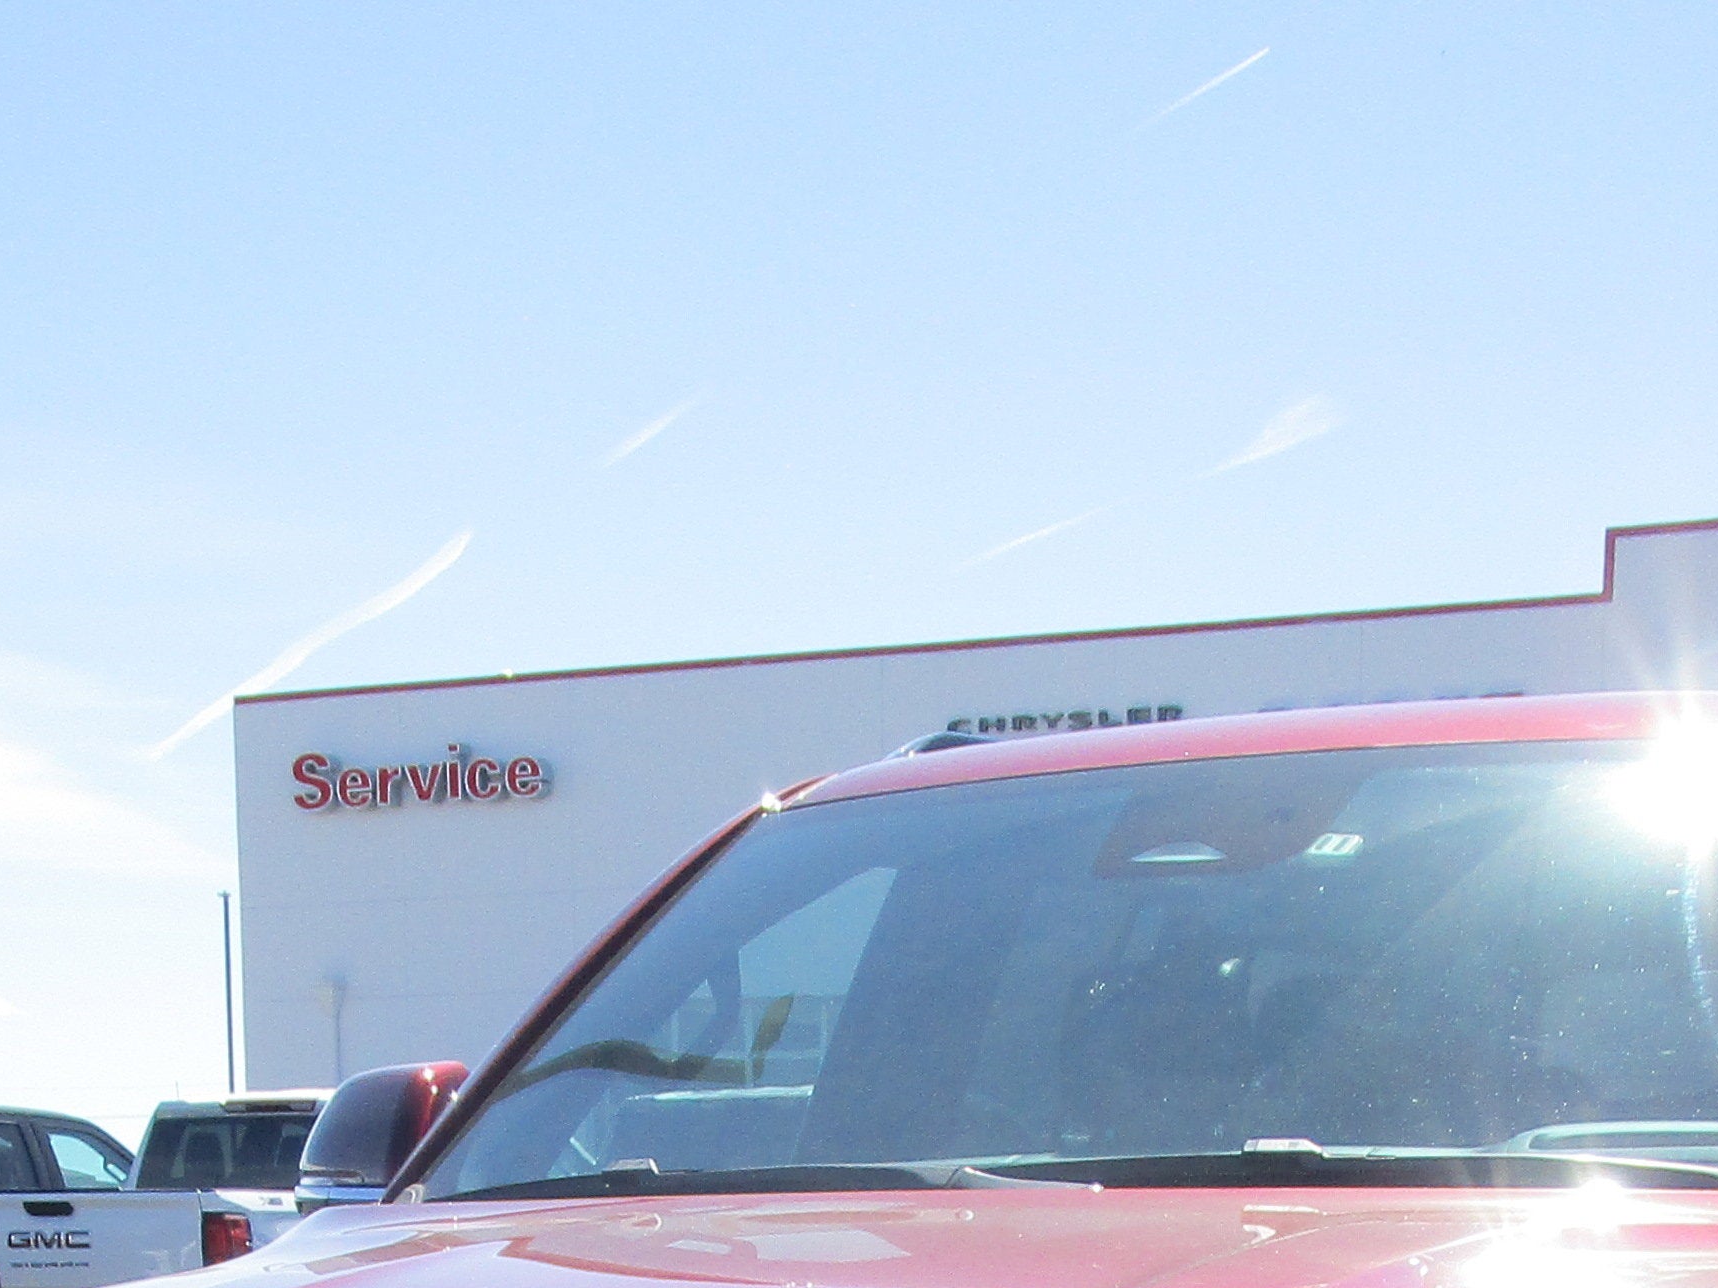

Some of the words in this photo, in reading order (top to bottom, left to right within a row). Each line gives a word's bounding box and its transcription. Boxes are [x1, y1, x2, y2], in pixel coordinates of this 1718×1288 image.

[947, 703, 1182, 734] CHRYSLER
[291, 743, 546, 812] Service
[8, 1231, 91, 1249] GMC
